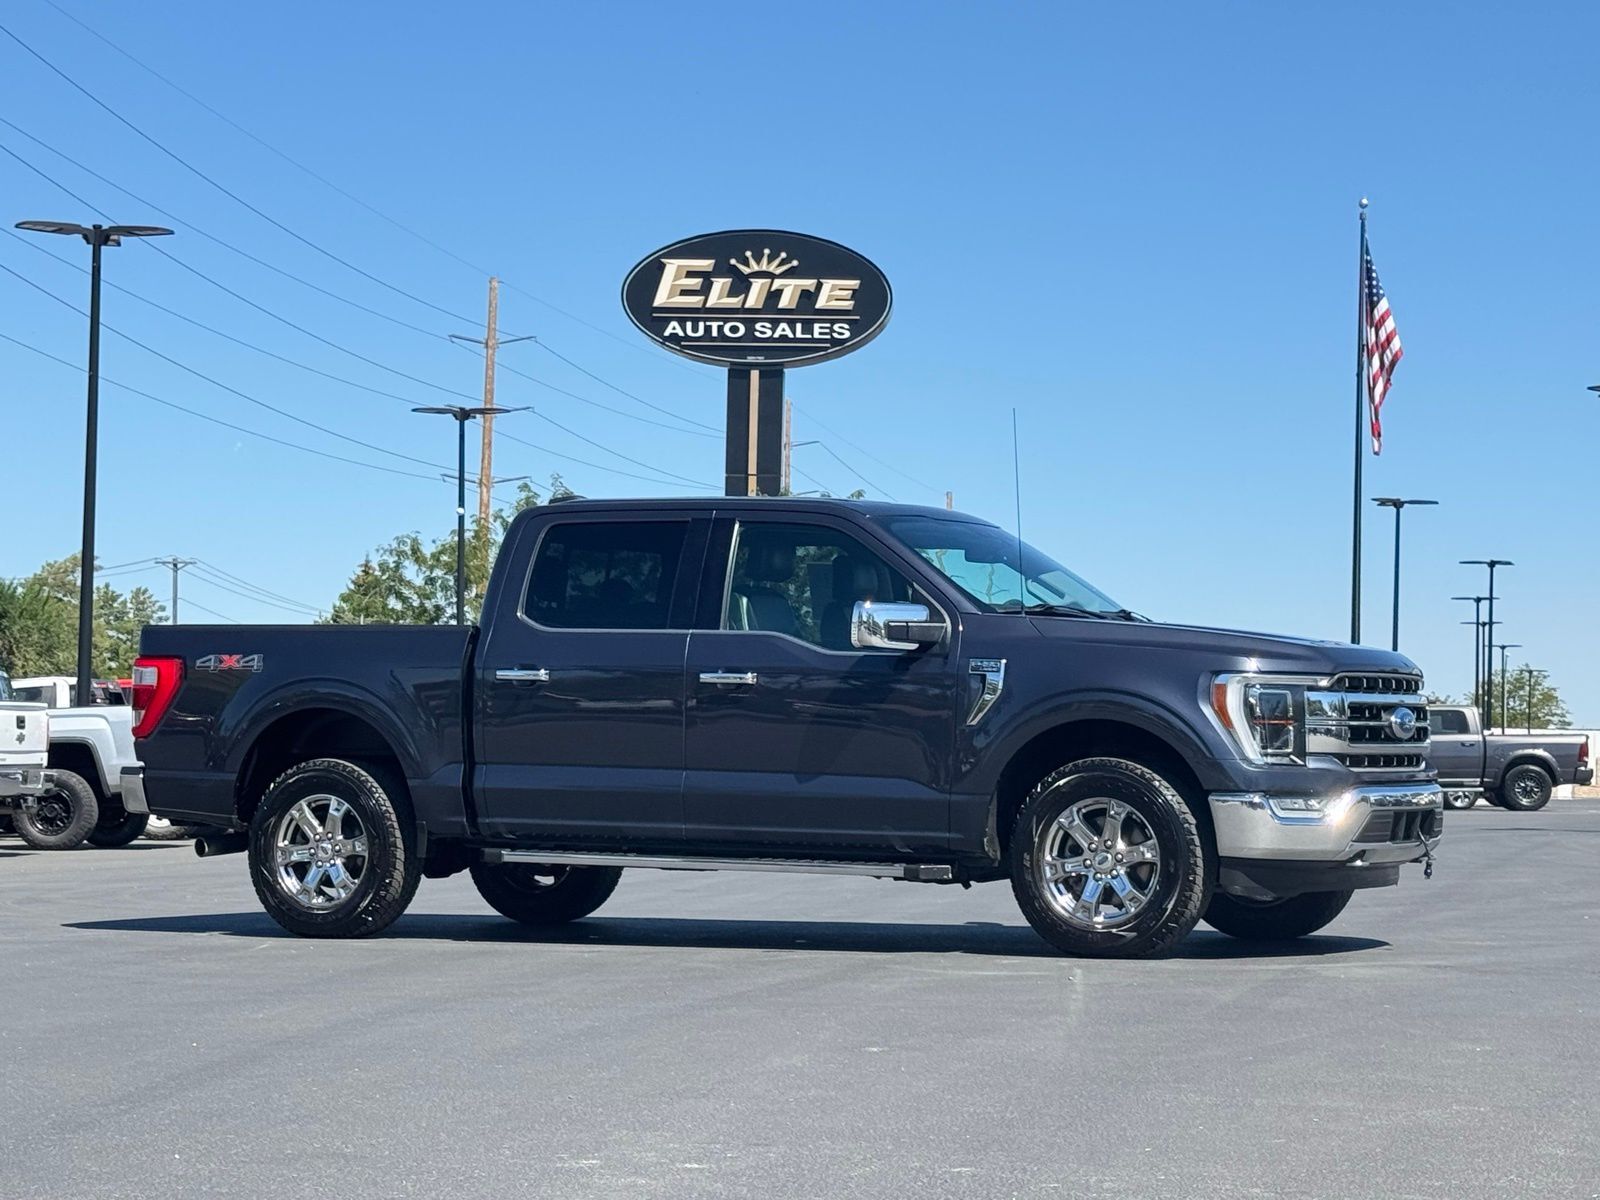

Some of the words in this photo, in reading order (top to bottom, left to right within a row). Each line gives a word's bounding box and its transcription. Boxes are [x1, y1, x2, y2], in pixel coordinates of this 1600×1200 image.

[652, 258, 861, 310] ELITE
[663, 321, 746, 338] AUTO
[753, 322, 851, 340] SALES
